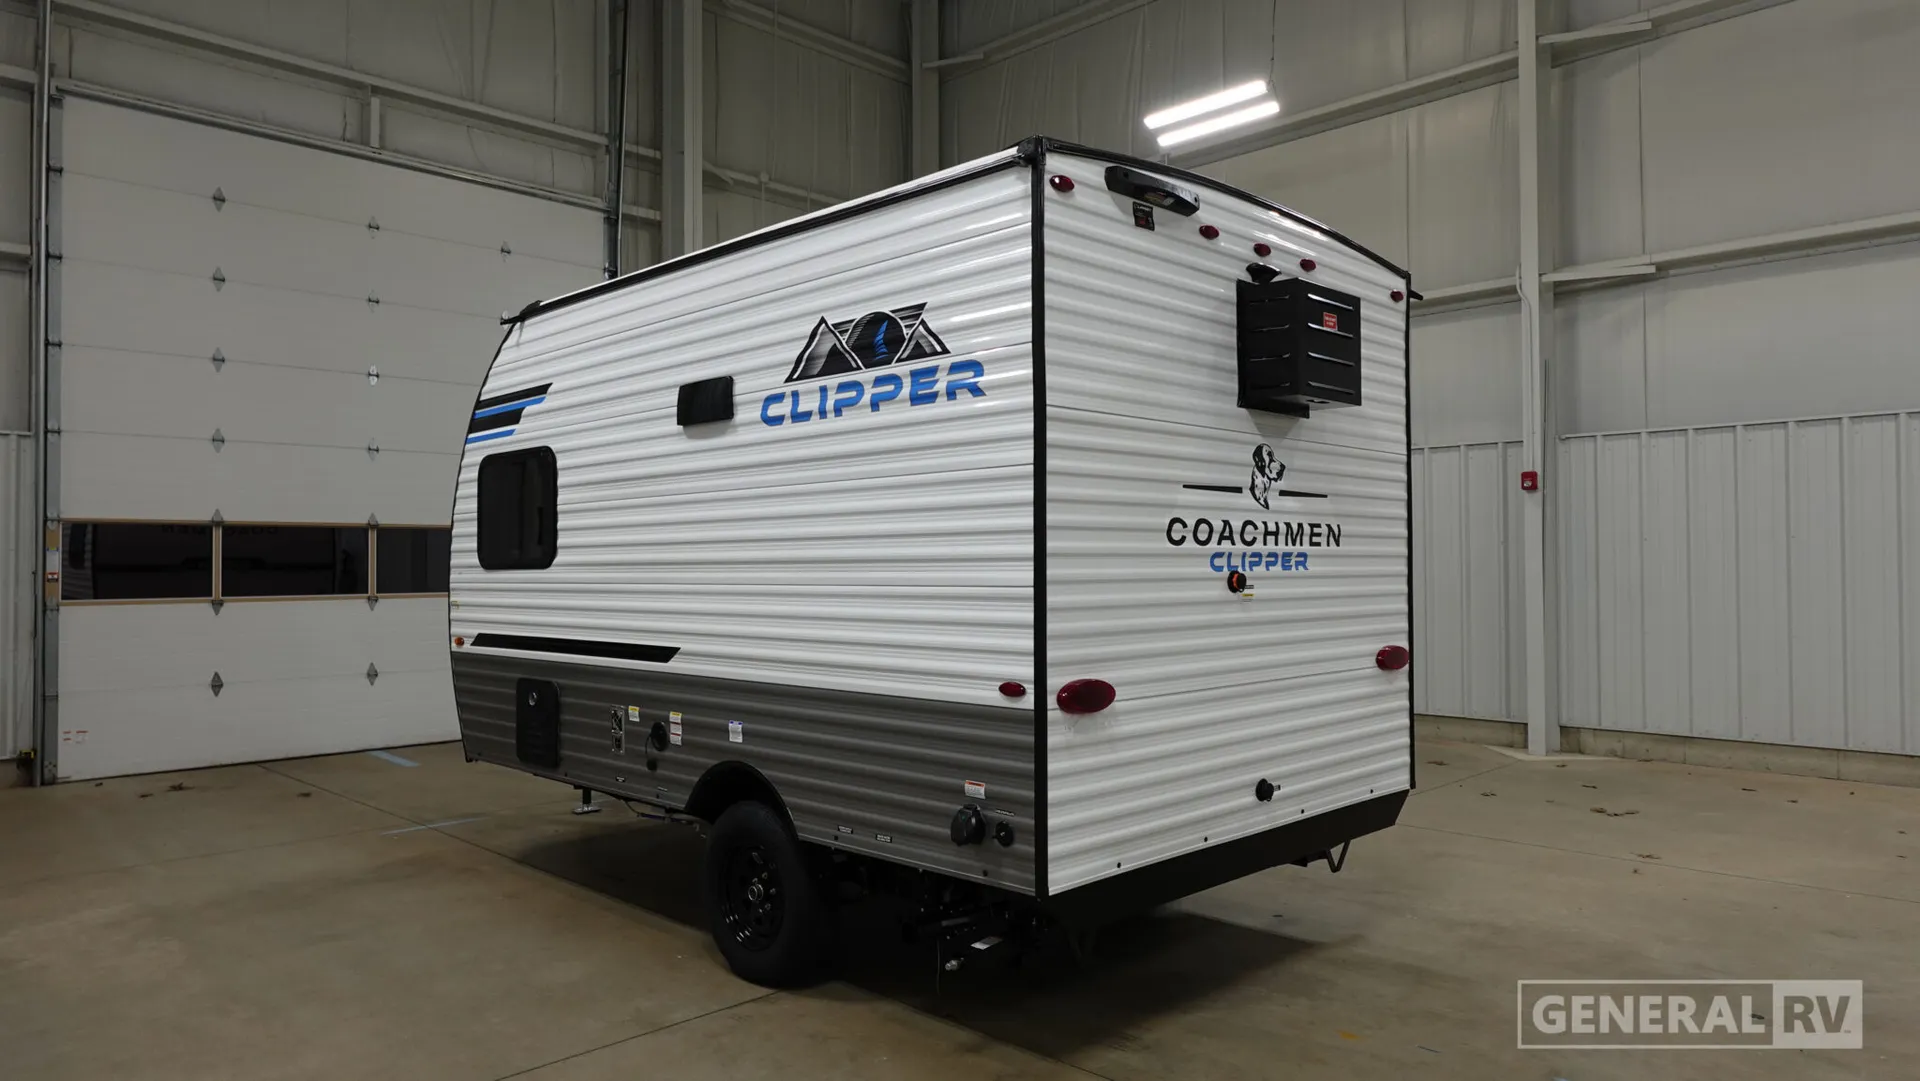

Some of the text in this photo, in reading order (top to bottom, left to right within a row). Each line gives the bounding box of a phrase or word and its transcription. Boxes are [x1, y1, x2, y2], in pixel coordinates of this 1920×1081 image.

[760, 359, 987, 426] CLIPPER
[1166, 517, 1342, 547] COACHMEN
[1209, 551, 1309, 573] CLIPPER
